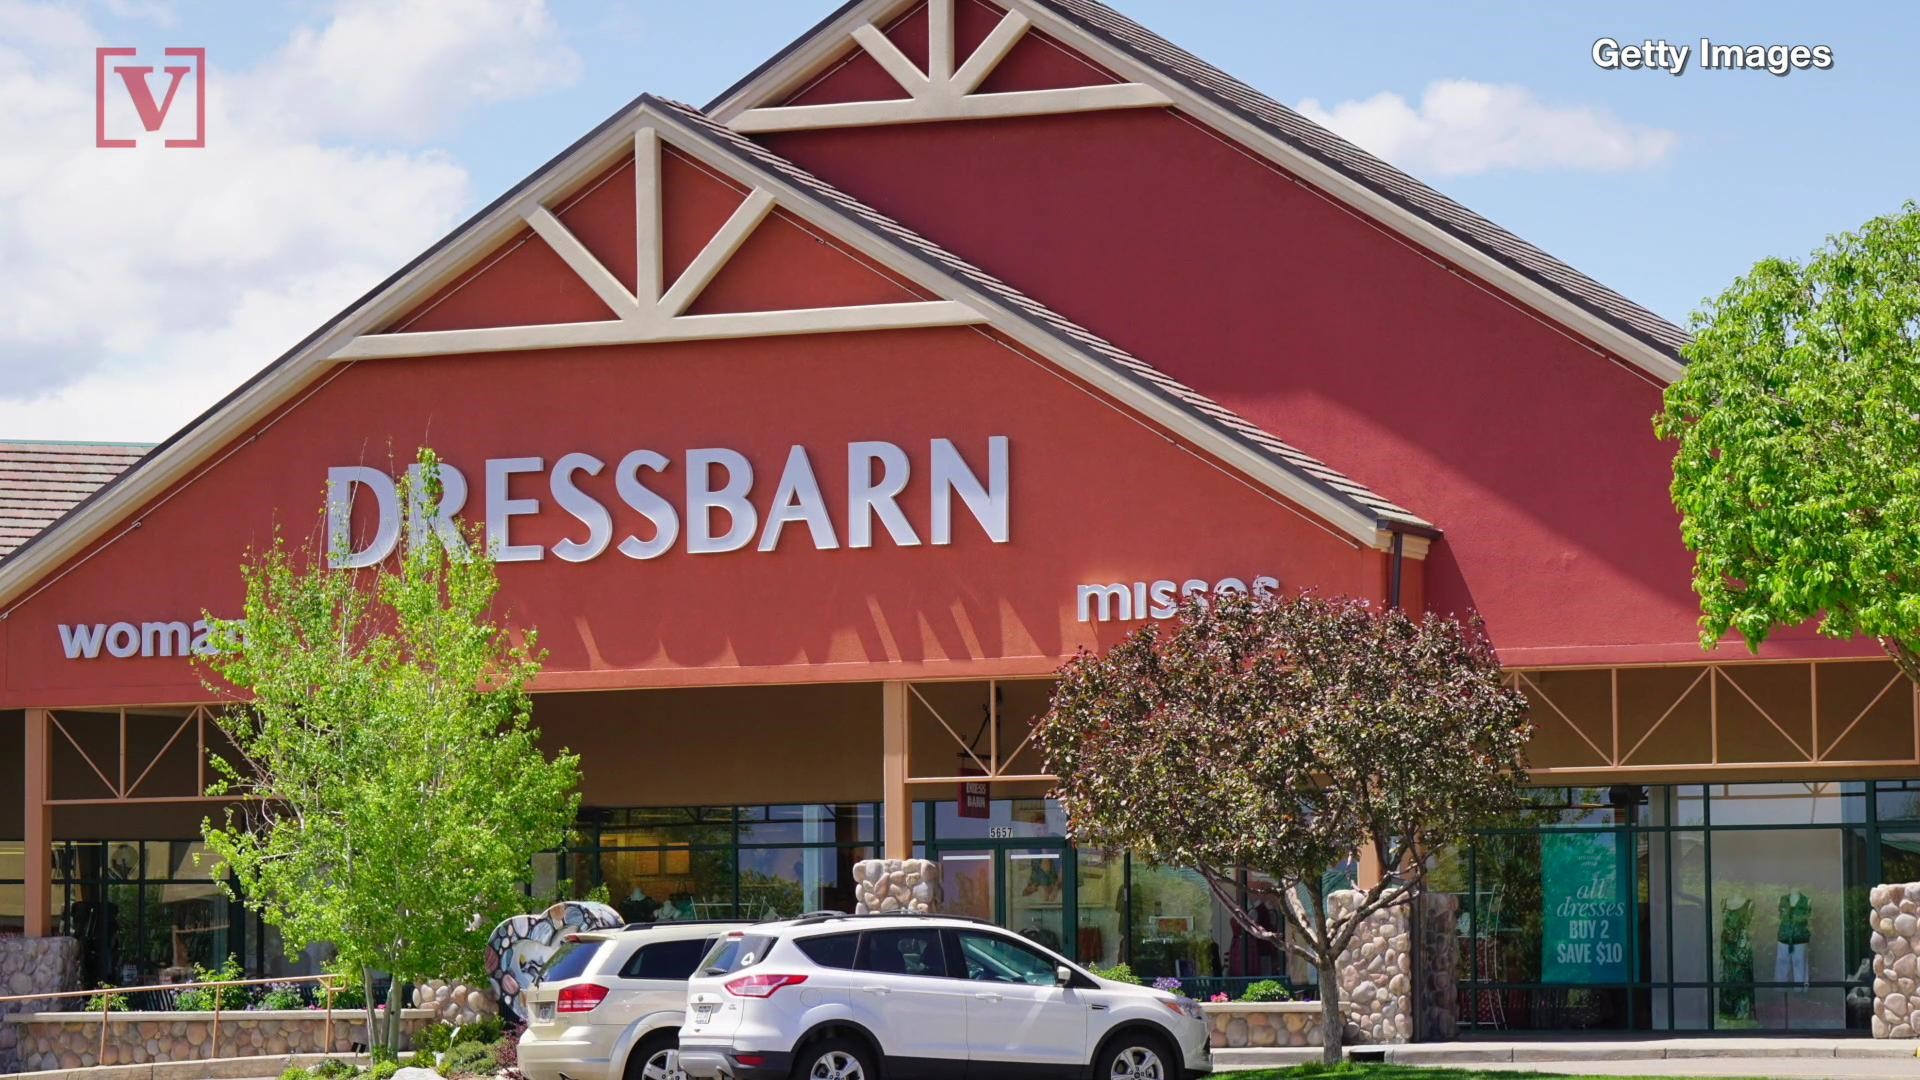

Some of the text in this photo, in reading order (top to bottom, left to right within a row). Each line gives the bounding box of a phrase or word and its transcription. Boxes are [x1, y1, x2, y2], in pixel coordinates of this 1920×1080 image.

[326, 435, 1009, 571] DRESSBARN
[990, 827, 1013, 838] 5657
[1576, 872, 1606, 899] all
[1556, 896, 1625, 917] dresses
[1569, 919, 1609, 939] BUY 2
[1557, 941, 1623, 965] SAVE $10
